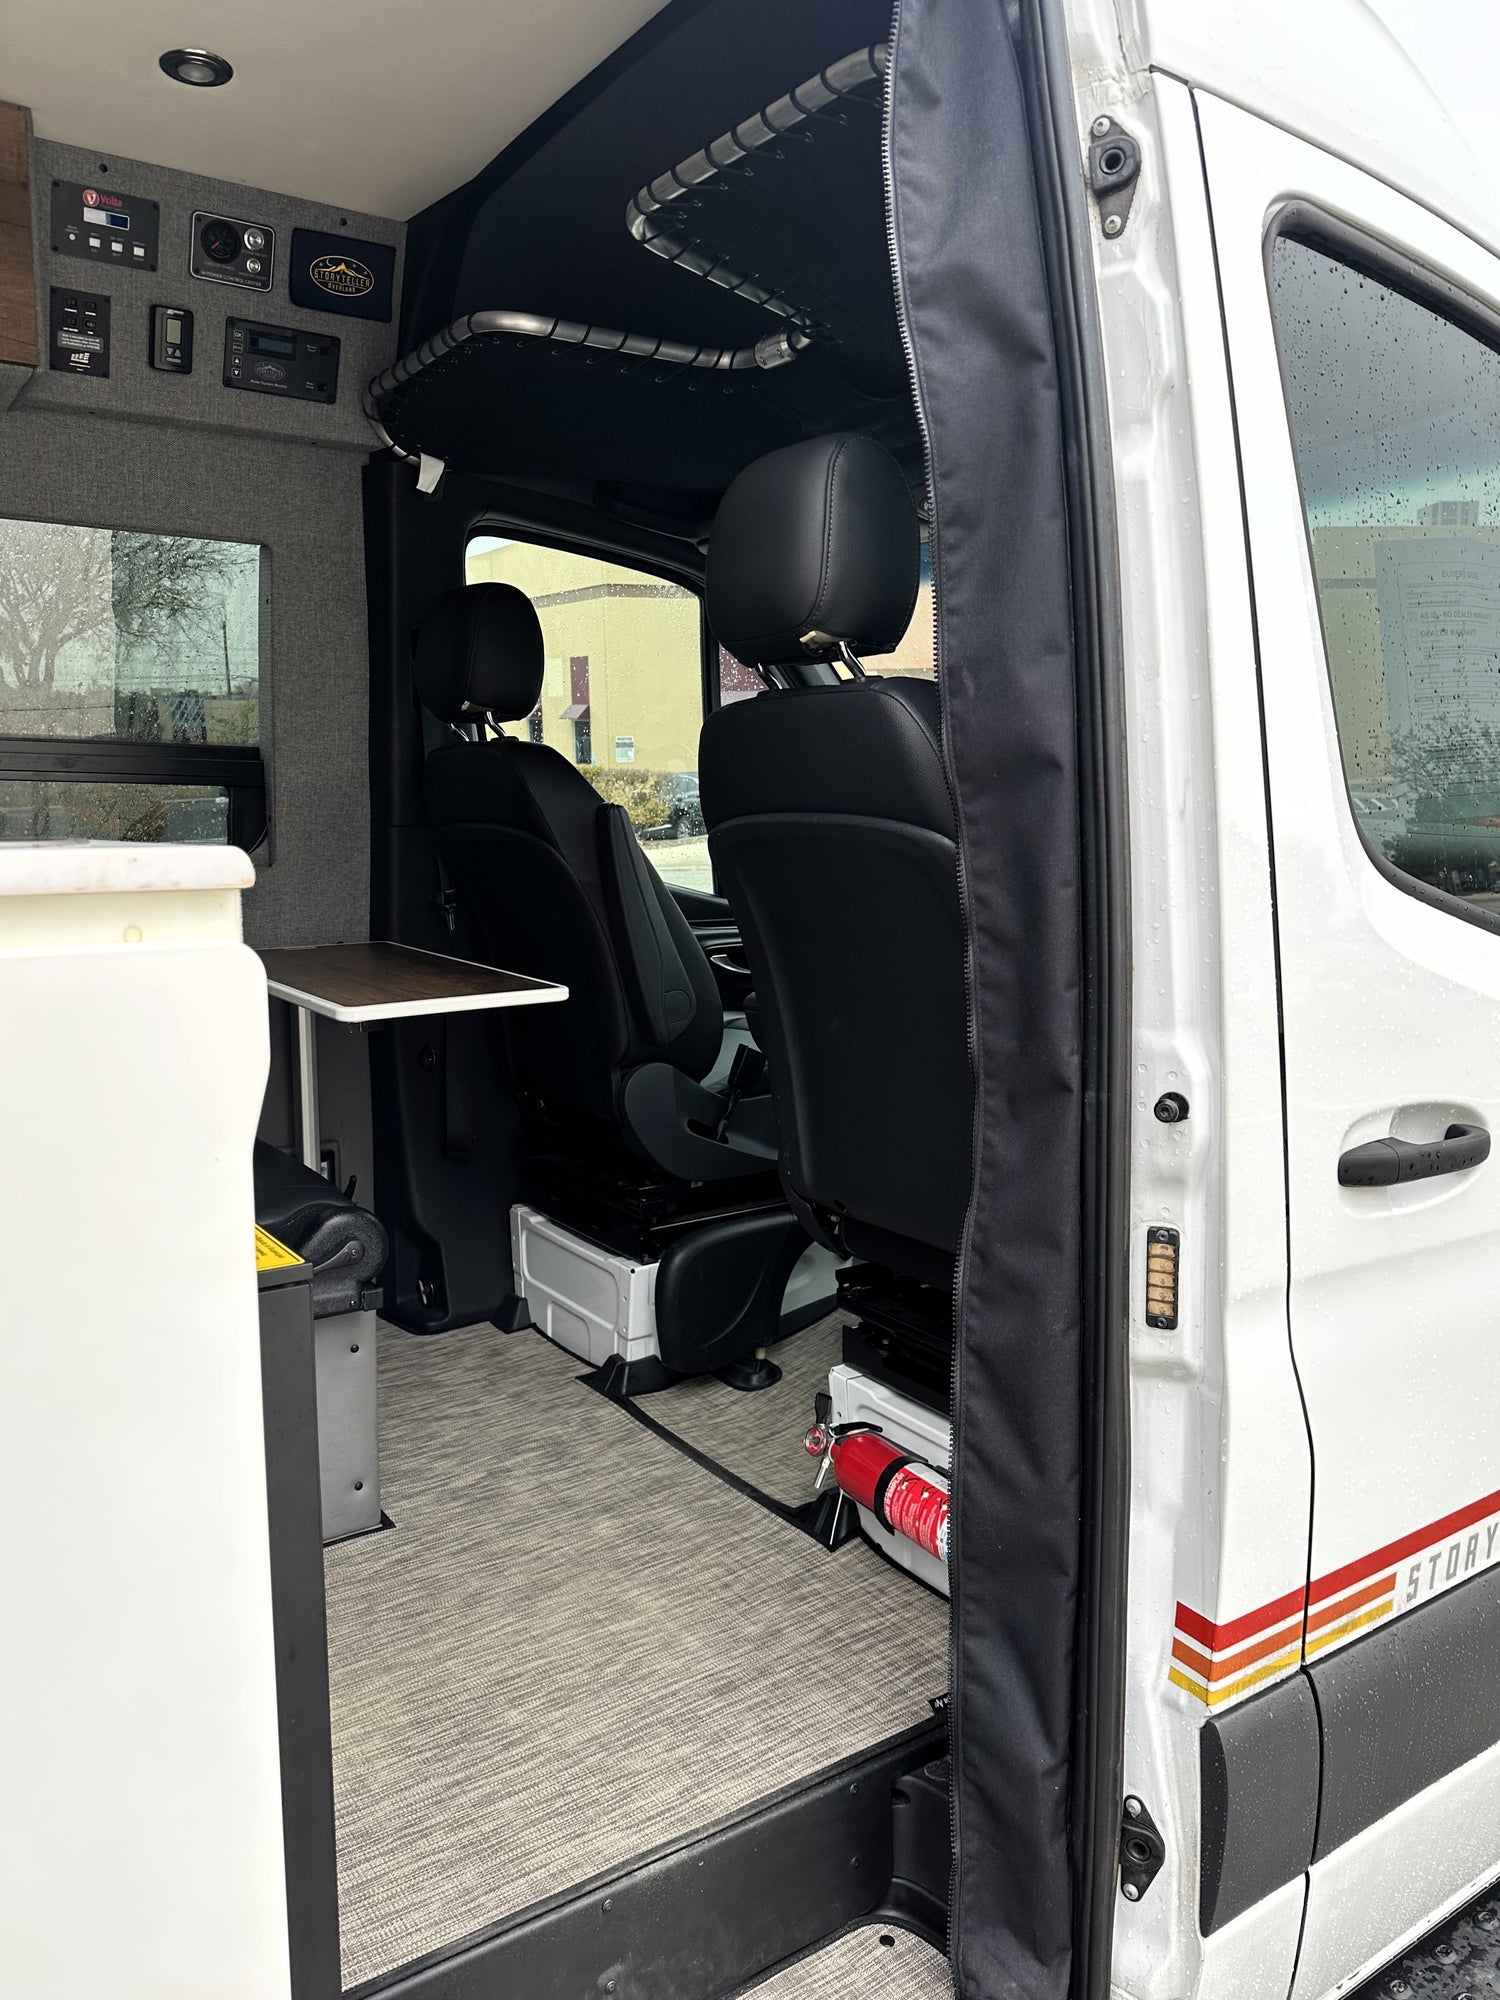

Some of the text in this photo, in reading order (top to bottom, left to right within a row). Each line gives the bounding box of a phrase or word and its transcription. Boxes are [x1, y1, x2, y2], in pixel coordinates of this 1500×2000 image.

[314, 270, 370, 288] STORYTELLER
[327, 282, 356, 293] OVERLAND
[1406, 1521, 1500, 1603] STORY
